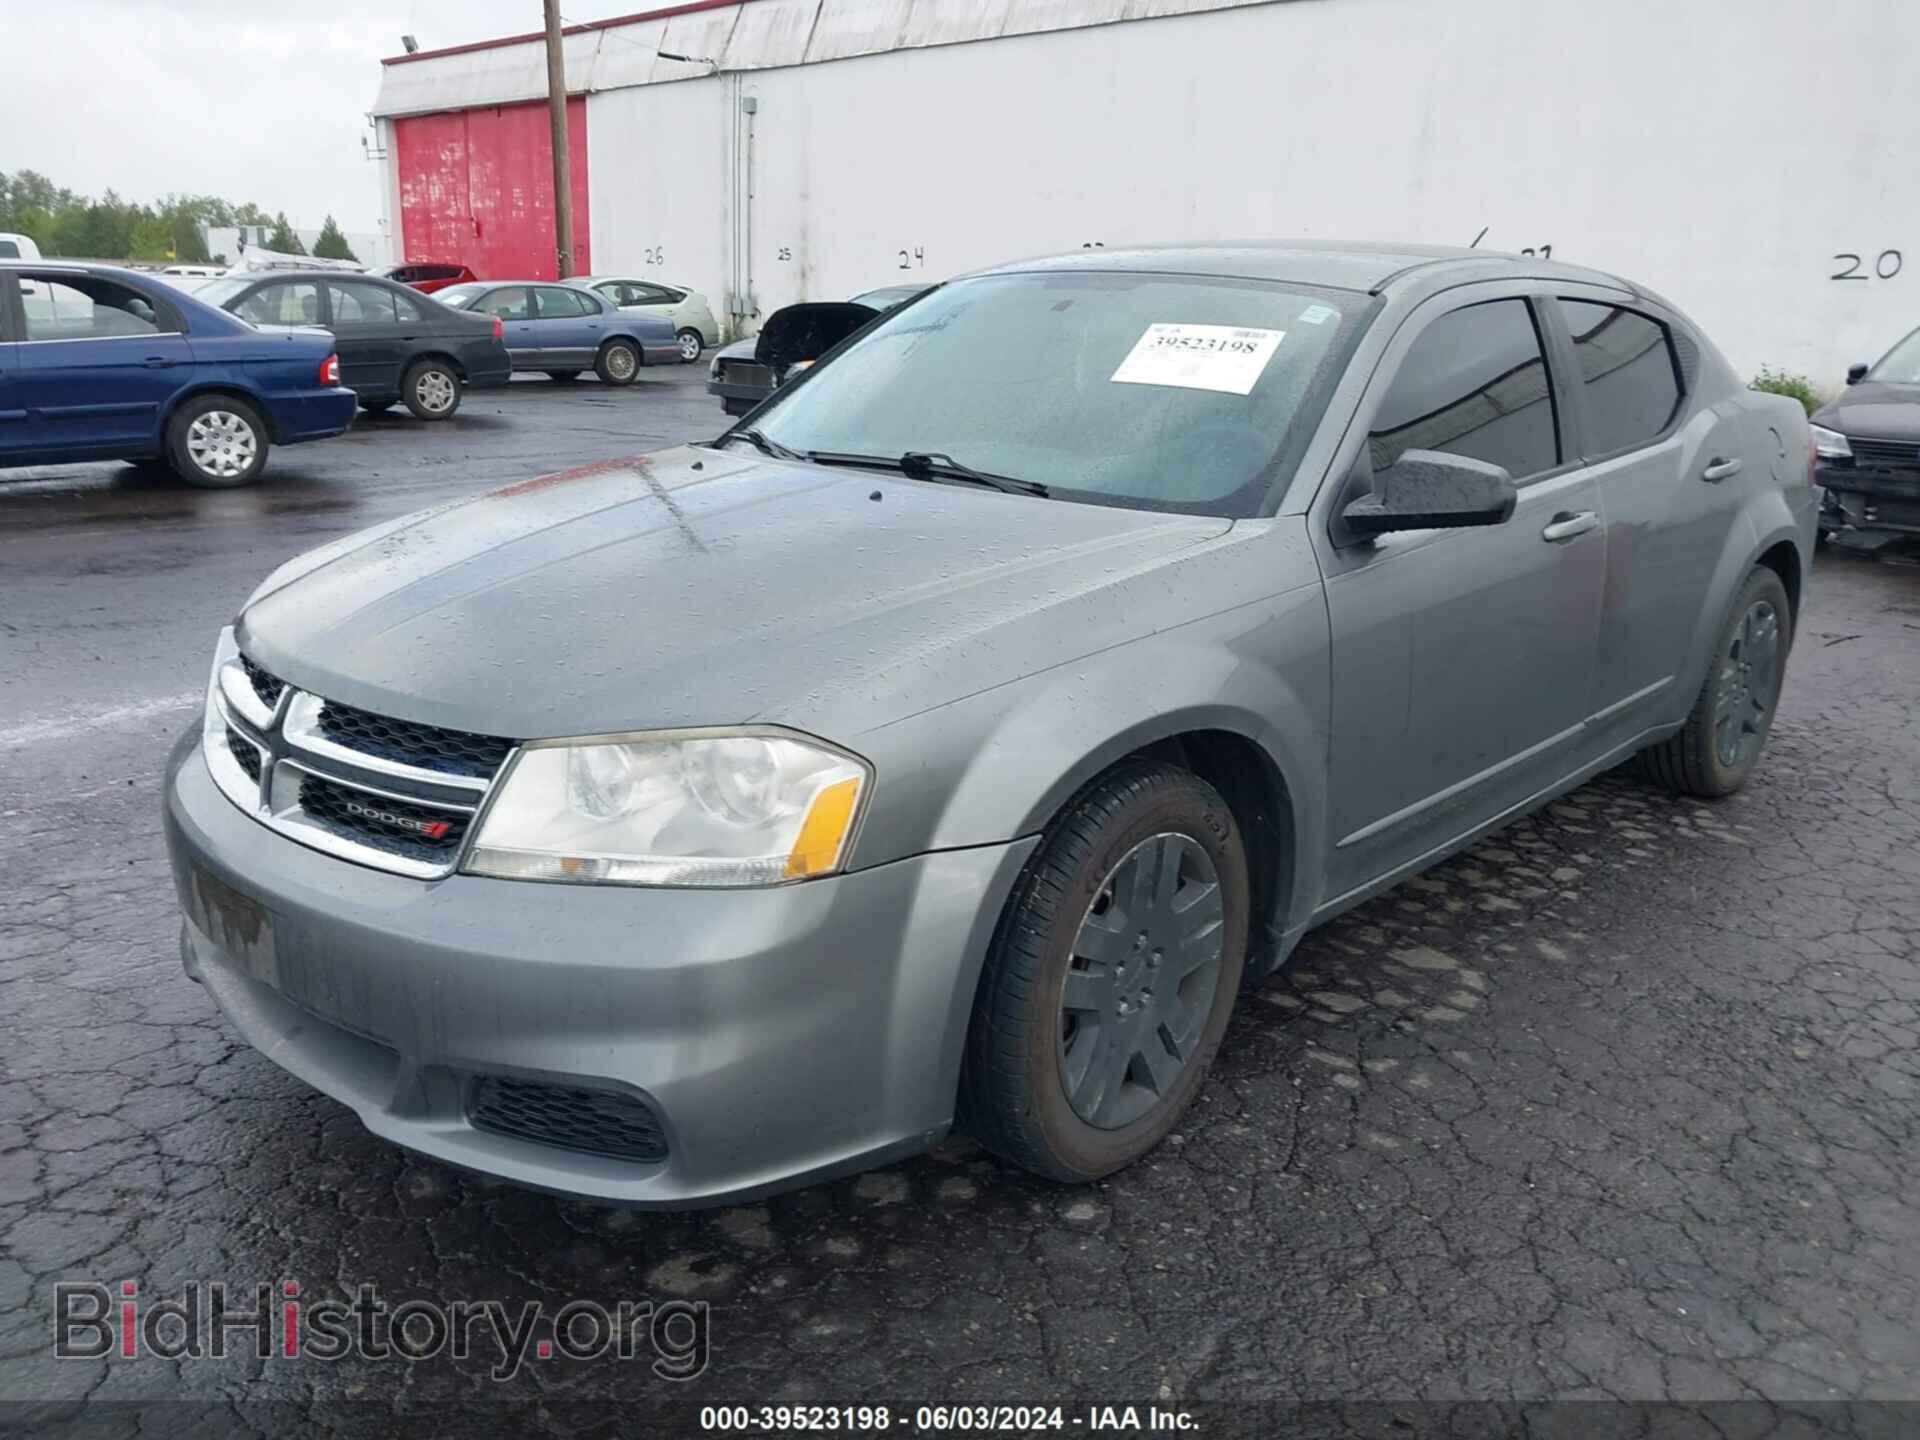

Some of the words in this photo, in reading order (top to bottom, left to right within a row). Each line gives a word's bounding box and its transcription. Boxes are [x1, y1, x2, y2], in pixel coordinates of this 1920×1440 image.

[644, 246, 664, 266] 26
[777, 247, 792, 261] 25
[898, 247, 924, 270] 24
[1830, 249, 1902, 280] 20
[1149, 336, 1259, 354] 39523198
[346, 802, 433, 834] DODGE
